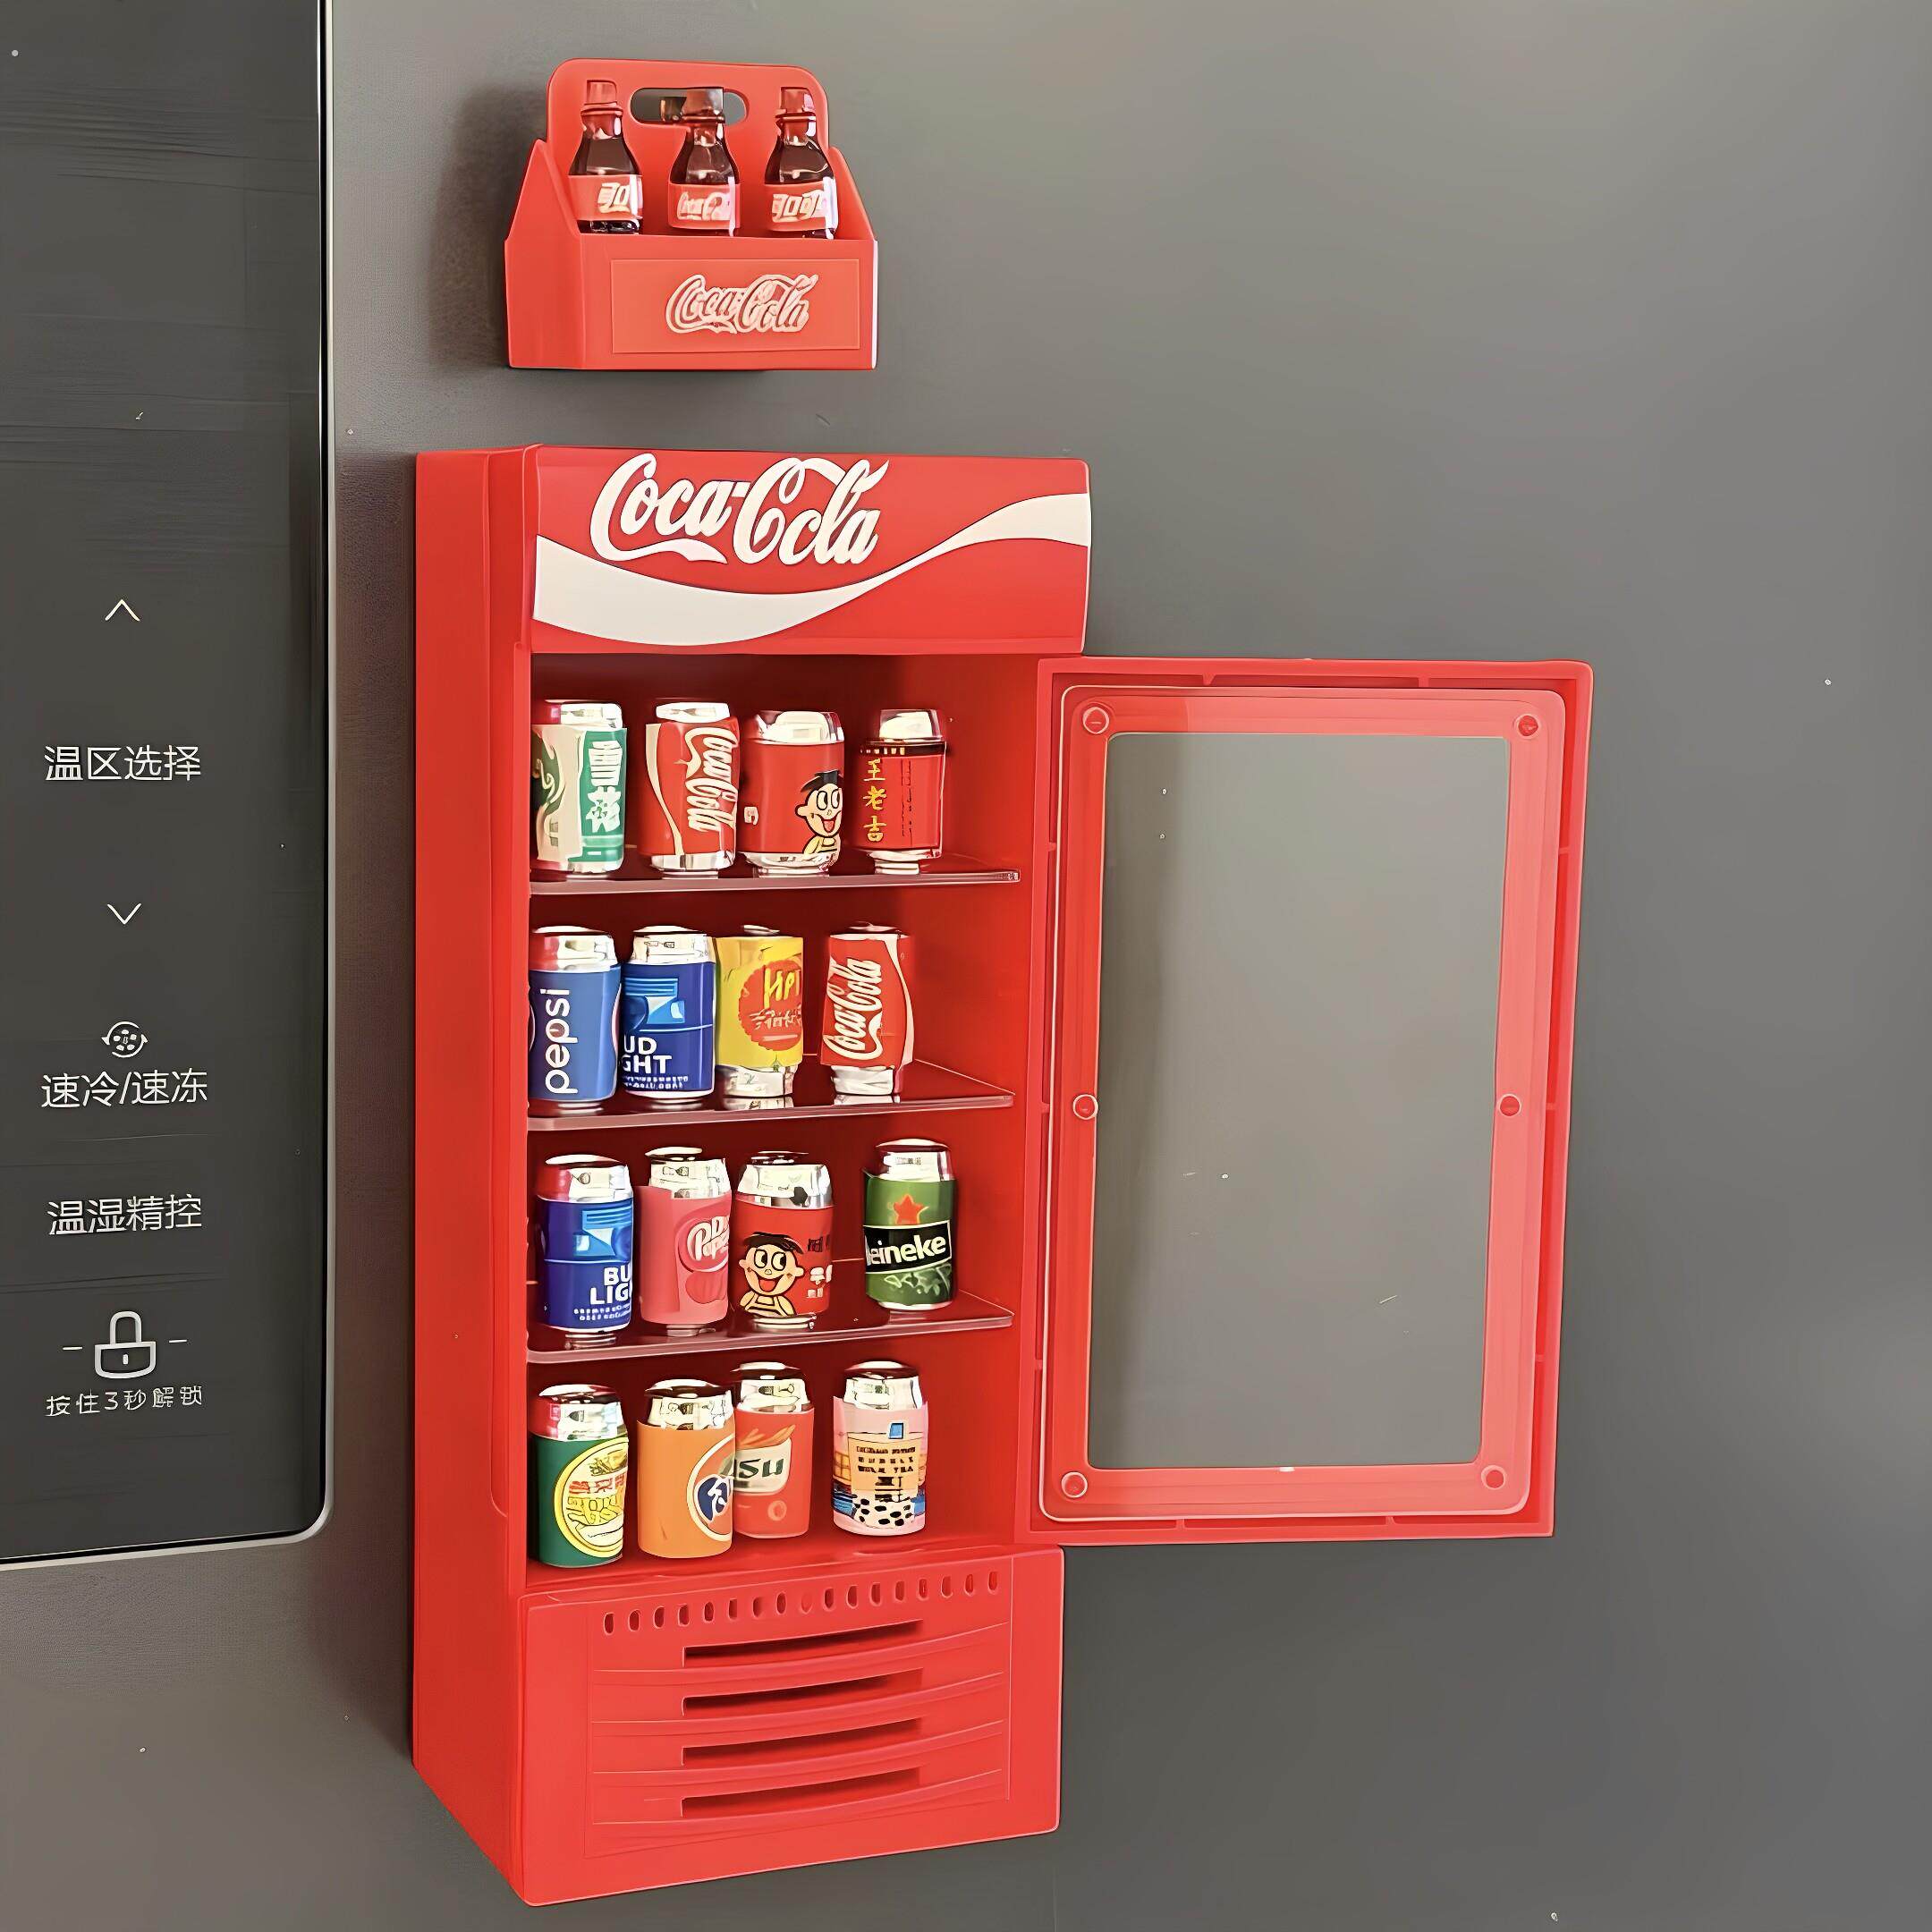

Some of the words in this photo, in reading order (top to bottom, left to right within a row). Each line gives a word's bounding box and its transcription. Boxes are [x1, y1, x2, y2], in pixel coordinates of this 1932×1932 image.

[44, 744, 201, 781] 温区选择
[863, 758, 887, 843] 王老吉
[539, 988, 579, 1095] pepsi
[41, 1067, 208, 1108] 速冷/速冻
[47, 1193, 202, 1236] 温湿精控
[45, 1385, 202, 1417] 按住3秒解锁
